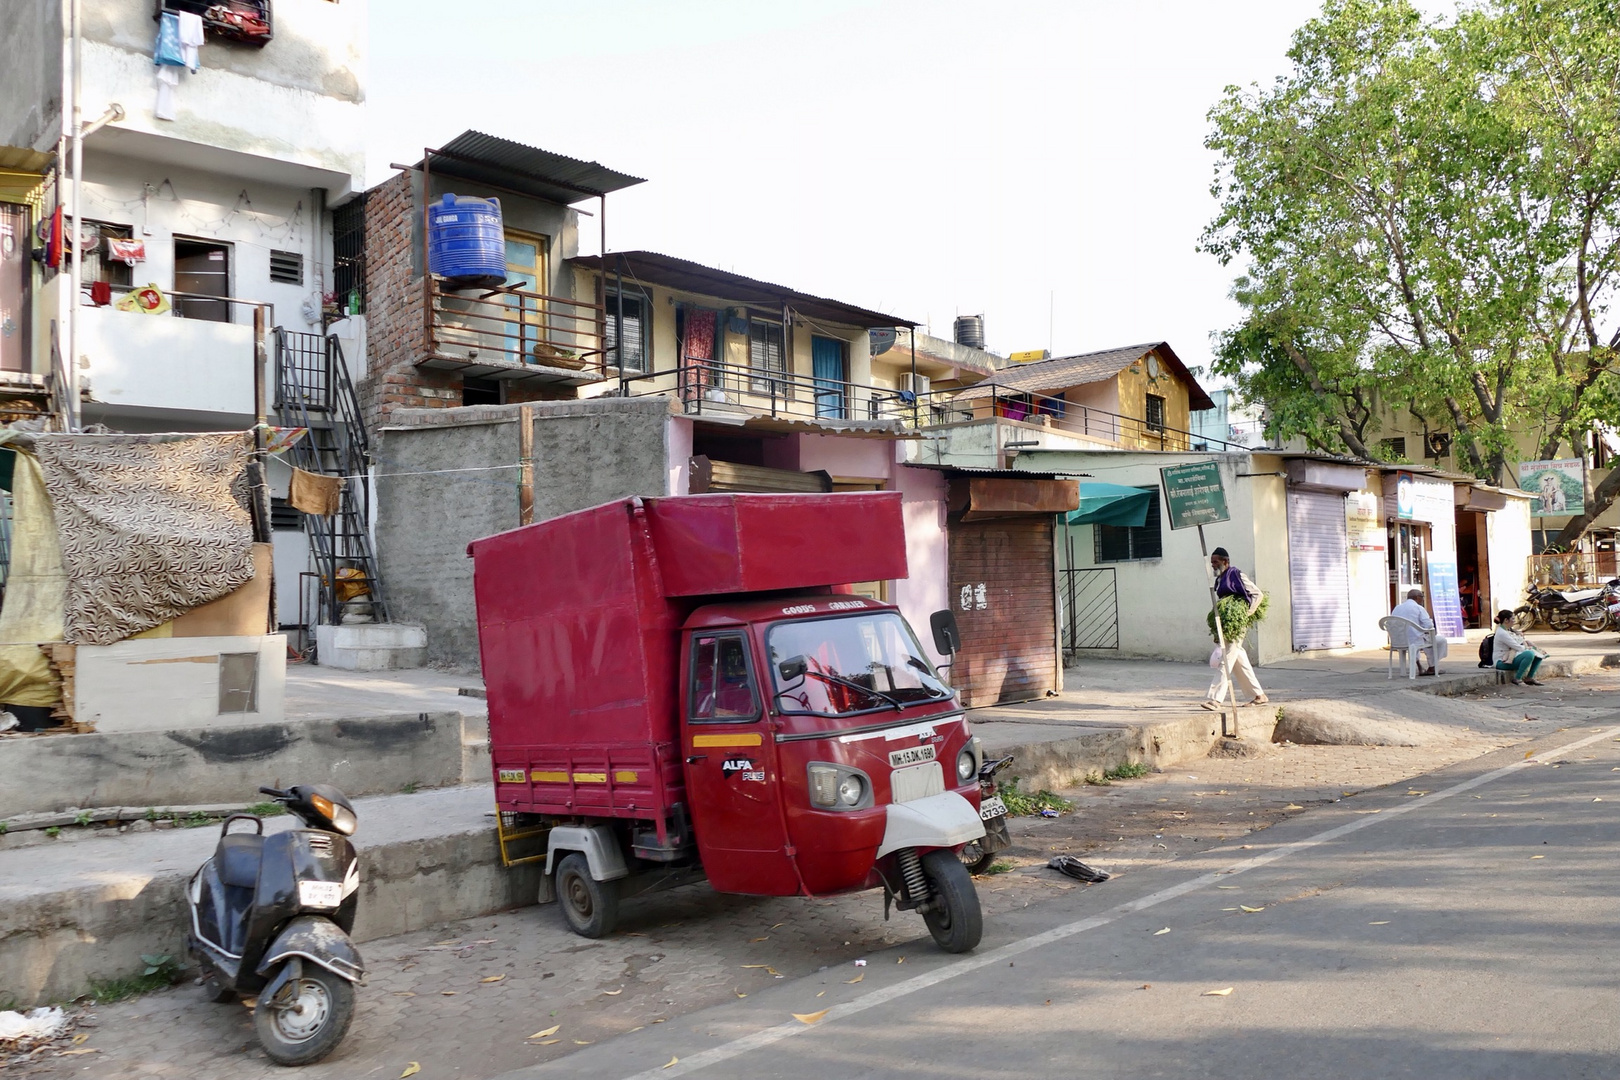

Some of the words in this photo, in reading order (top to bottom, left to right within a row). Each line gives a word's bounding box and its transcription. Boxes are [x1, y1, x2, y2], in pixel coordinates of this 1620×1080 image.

[828, 600, 868, 611] CARRIER
[722, 760, 753, 770] ALFA
[742, 772, 765, 781] PLUS
[982, 804, 1006, 818] 4733
